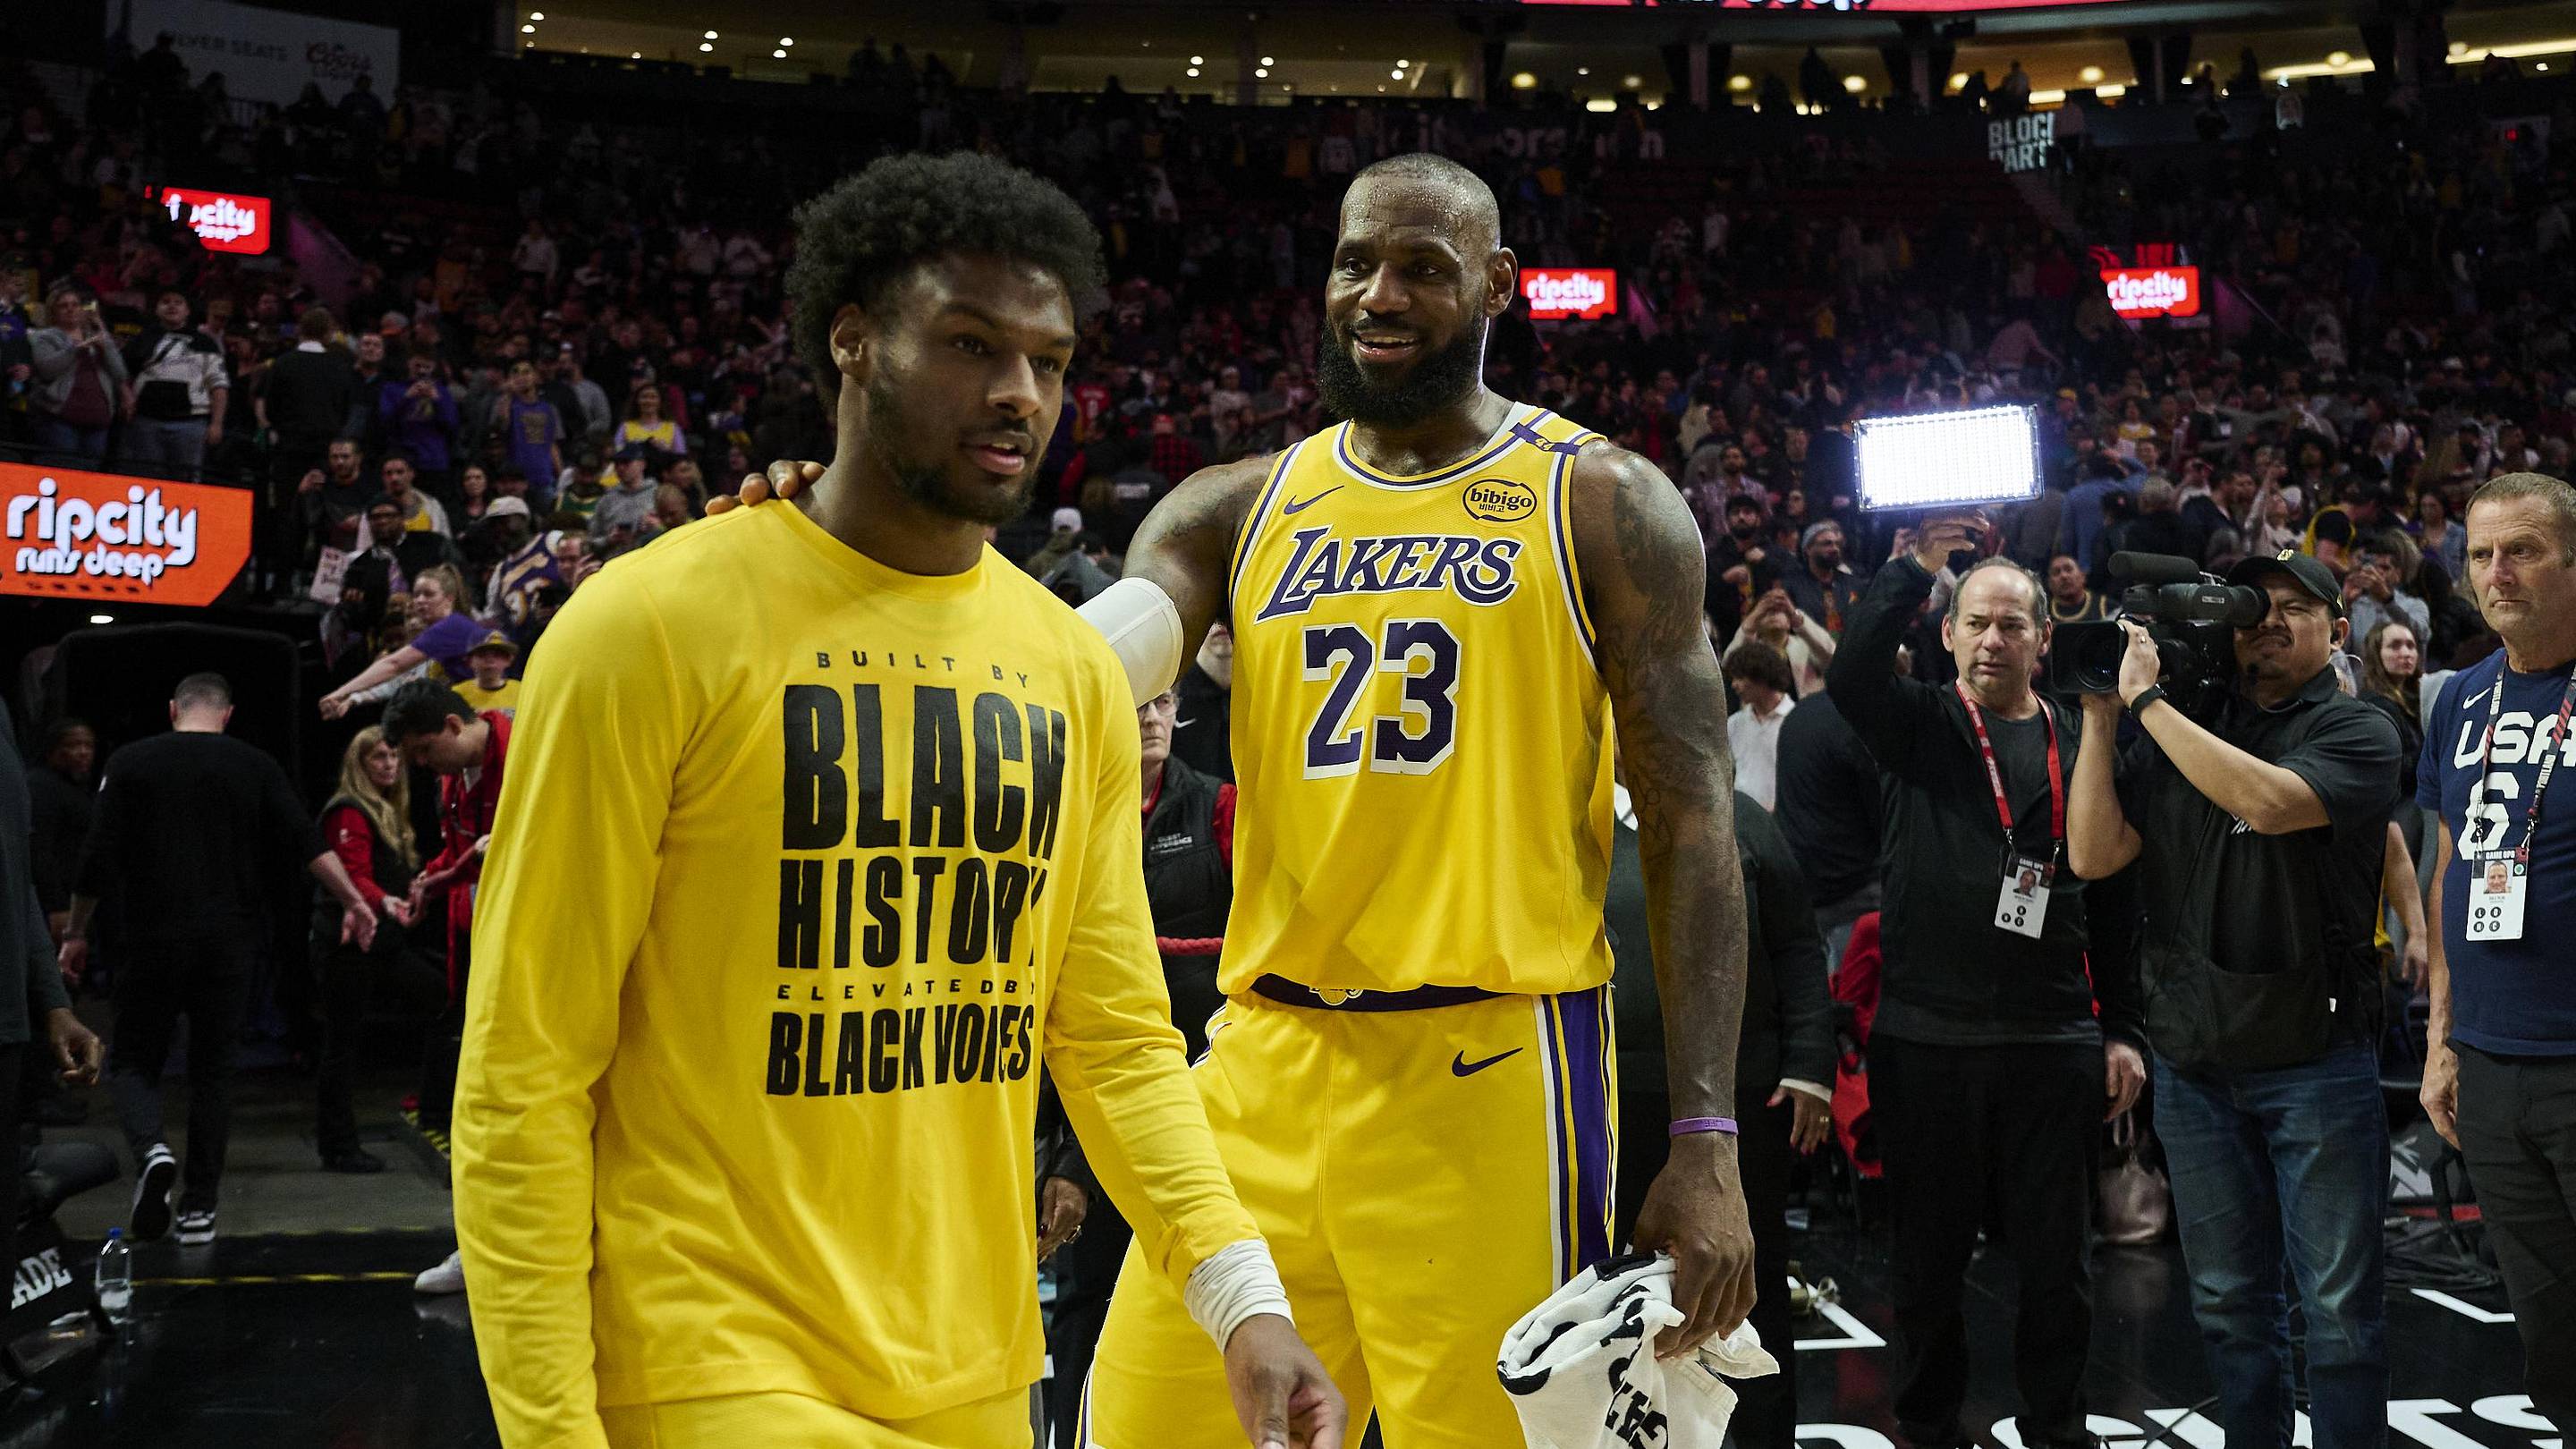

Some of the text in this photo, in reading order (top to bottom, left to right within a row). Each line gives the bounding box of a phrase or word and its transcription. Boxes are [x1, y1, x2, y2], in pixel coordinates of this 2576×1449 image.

[1526, 272, 1606, 305] ripcity
[2106, 271, 2188, 301] ripcity
[6, 477, 197, 567] ripcity
[1470, 487, 1533, 511] bibigo
[15, 541, 165, 587] runs deep
[1253, 523, 1525, 625] LAKERS
[817, 650, 1029, 689] BUILT BY
[1301, 618, 1462, 780] 23
[2453, 711, 2576, 769] USA
[783, 683, 1066, 860] BLACK
[2457, 771, 2521, 860] 6
[776, 979, 995, 1001] ELEVATED
[766, 1002, 1034, 1097] BLACK VOIES
